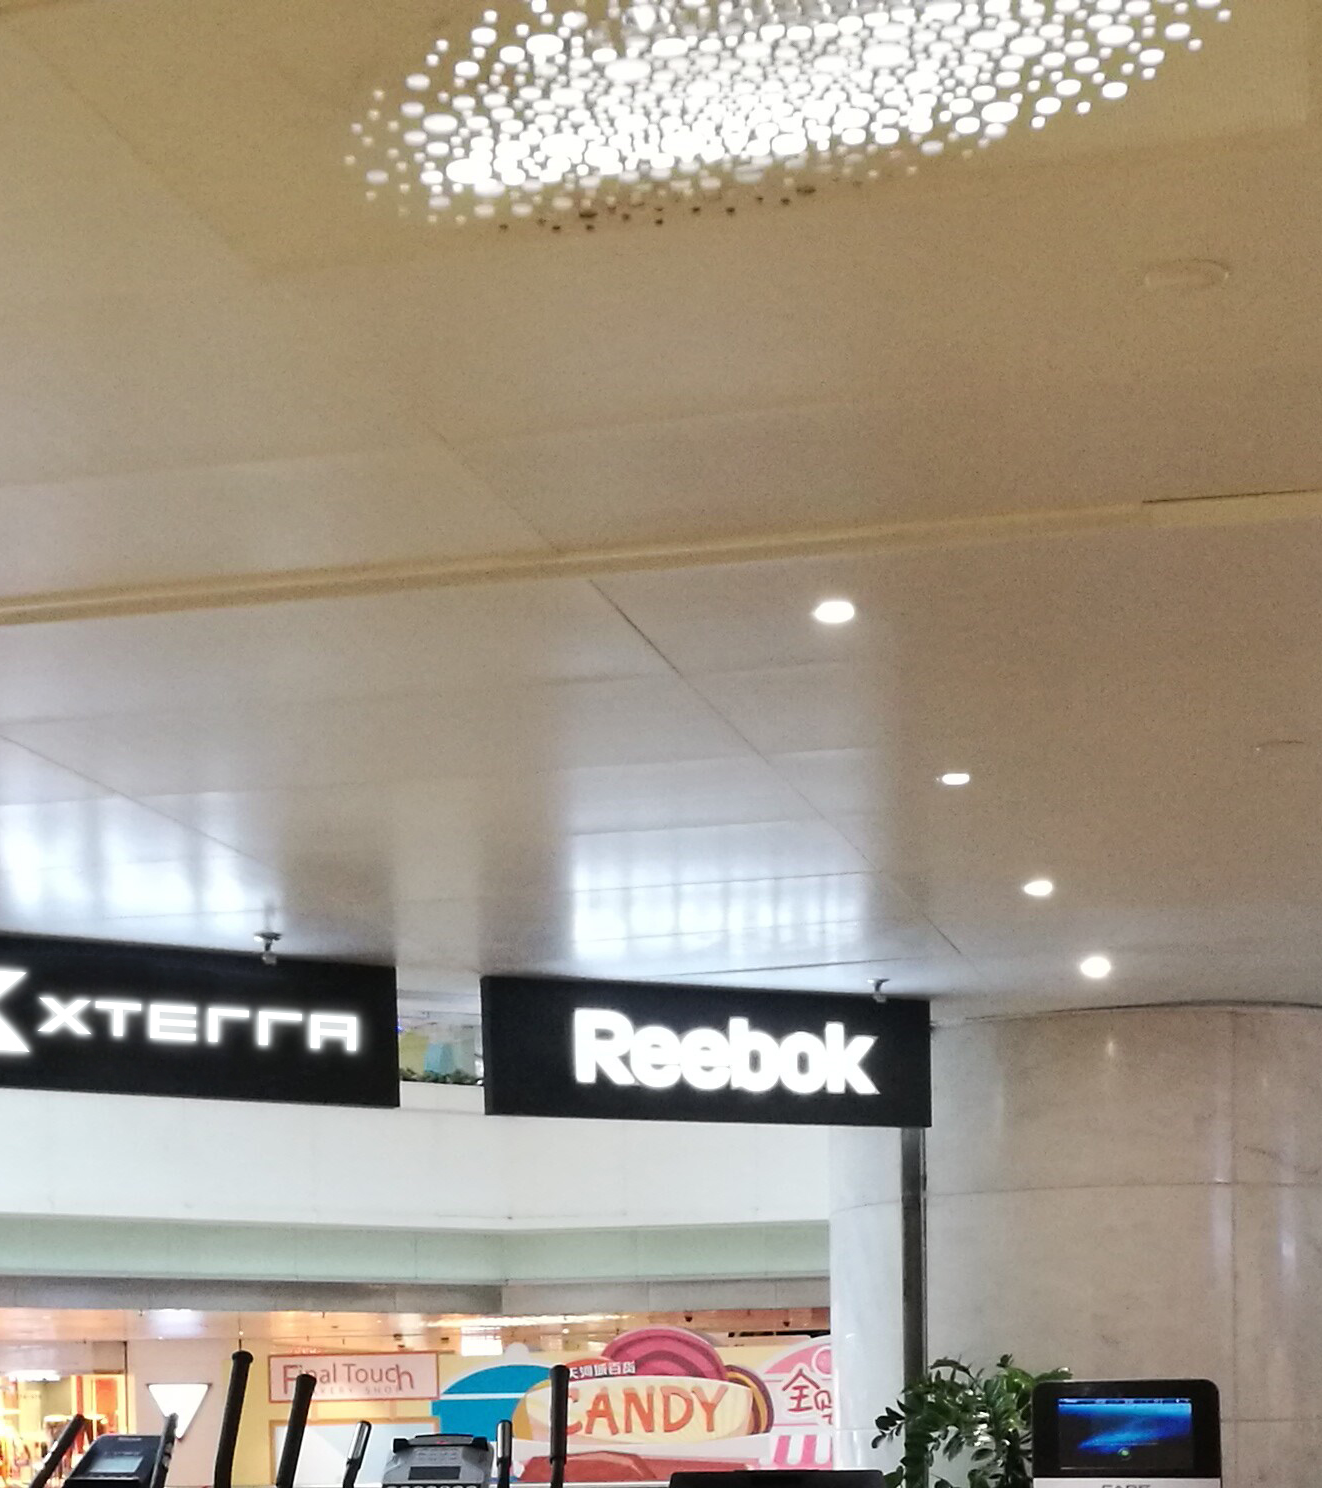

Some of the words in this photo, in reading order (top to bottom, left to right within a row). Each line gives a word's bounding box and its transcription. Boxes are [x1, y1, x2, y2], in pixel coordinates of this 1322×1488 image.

[37, 996, 359, 1052] XTERRA
[573, 1008, 880, 1096] Reebok
[341, 1362, 414, 1391] Touch
